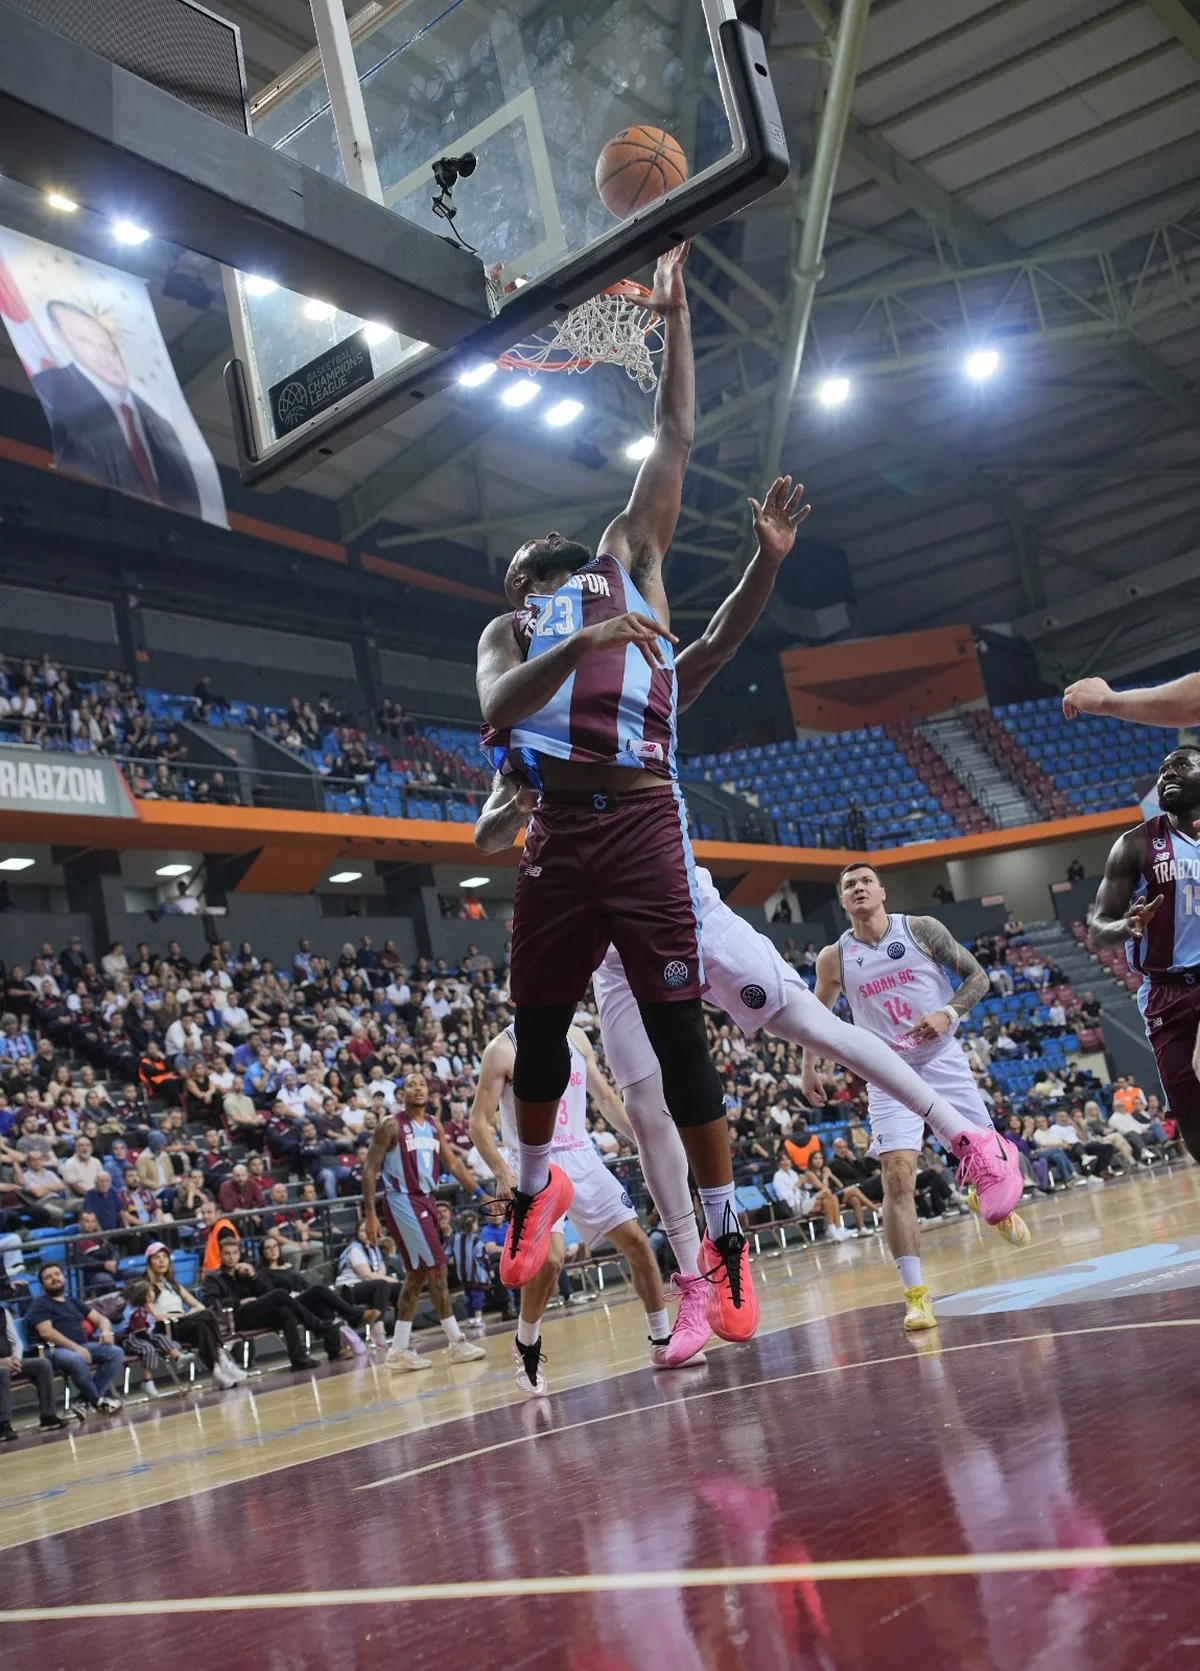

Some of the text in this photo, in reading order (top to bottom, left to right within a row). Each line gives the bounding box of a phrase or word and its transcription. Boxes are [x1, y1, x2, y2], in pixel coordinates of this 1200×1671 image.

[306, 346, 358, 383] BASKETBALL
[307, 351, 364, 395] CHAMPIONS
[309, 374, 348, 406] LEAGUE
[537, 595, 574, 636] 23
[0, 760, 106, 805] RABZON
[1153, 858, 1200, 885] TRABZO
[858, 968, 915, 999] SABAH BC
[883, 996, 913, 1026] 14
